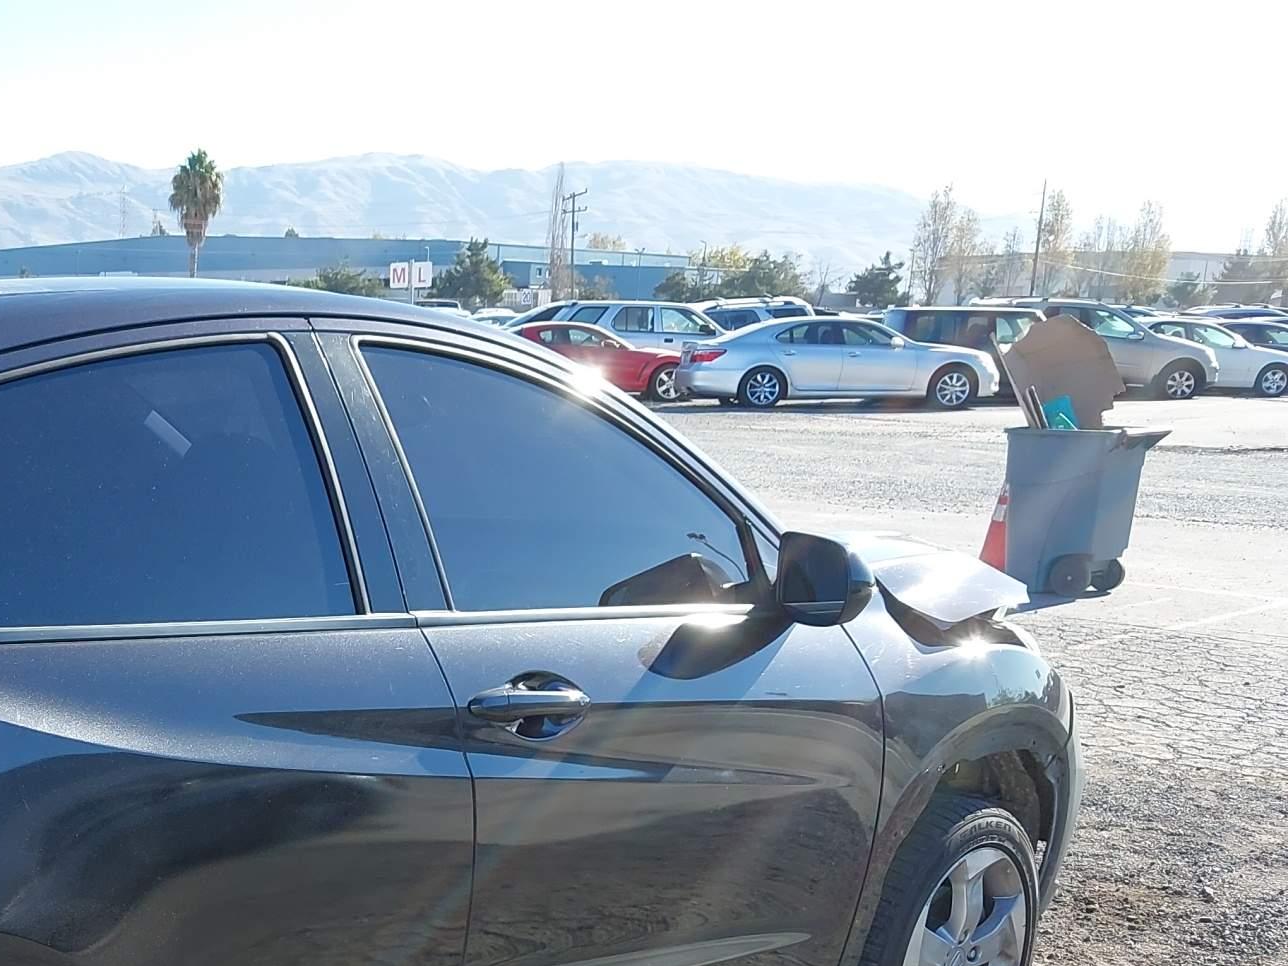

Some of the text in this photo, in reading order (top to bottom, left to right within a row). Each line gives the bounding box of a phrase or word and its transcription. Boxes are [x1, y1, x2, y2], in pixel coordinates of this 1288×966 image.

[392, 266, 406, 284] M
[418, 267, 427, 283] L
[522, 291, 531, 303] 20
